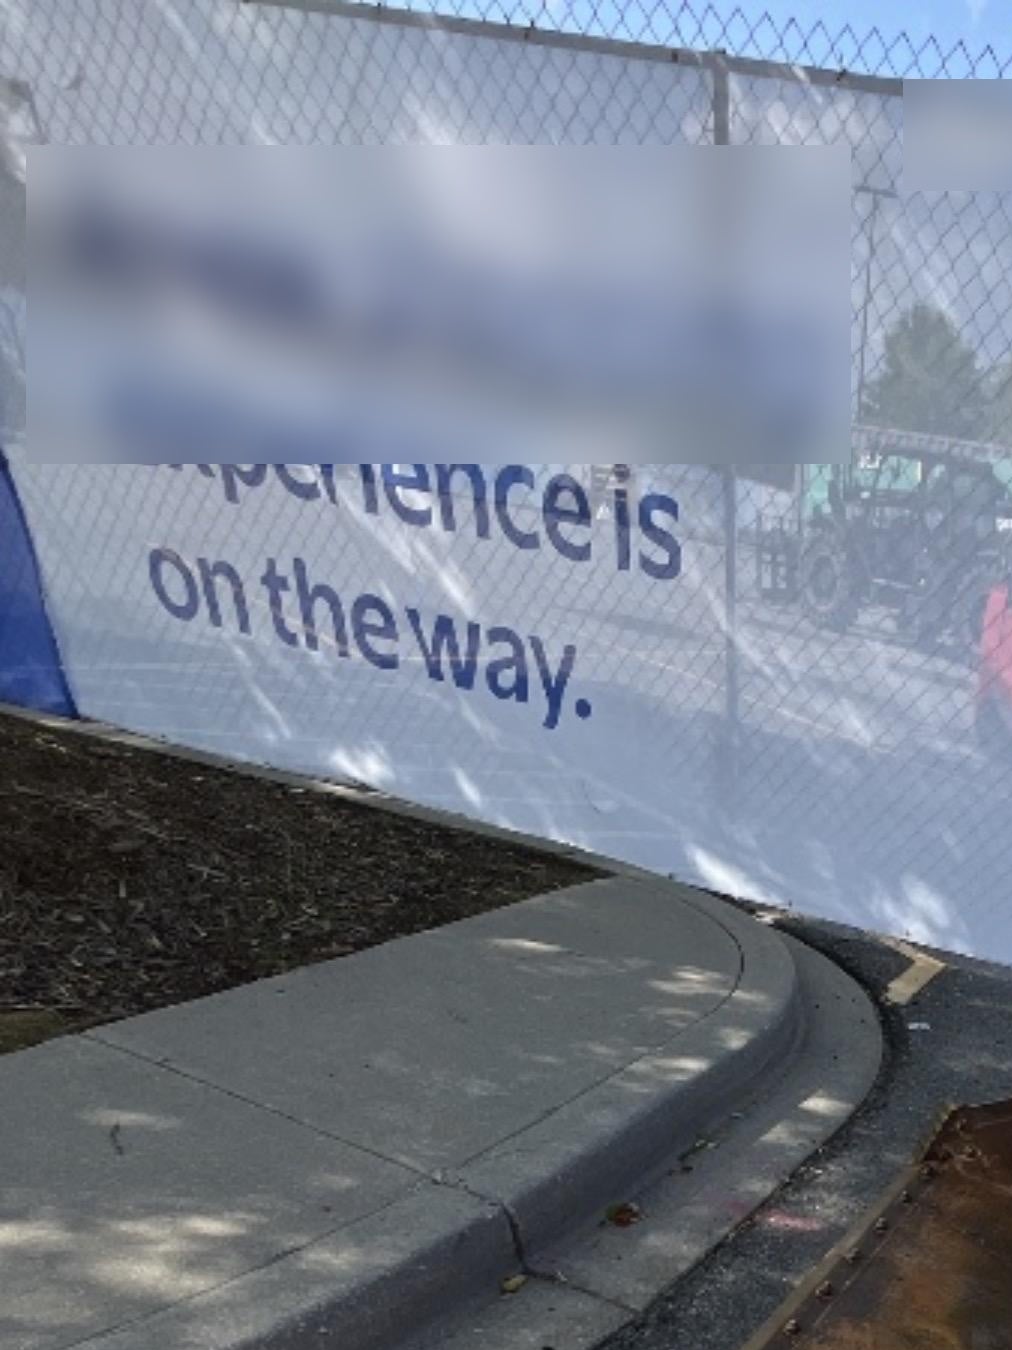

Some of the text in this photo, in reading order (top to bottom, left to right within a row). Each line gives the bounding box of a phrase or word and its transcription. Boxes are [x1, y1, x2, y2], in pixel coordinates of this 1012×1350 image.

[613, 463, 682, 580] is
[149, 548, 592, 730] on the way.
